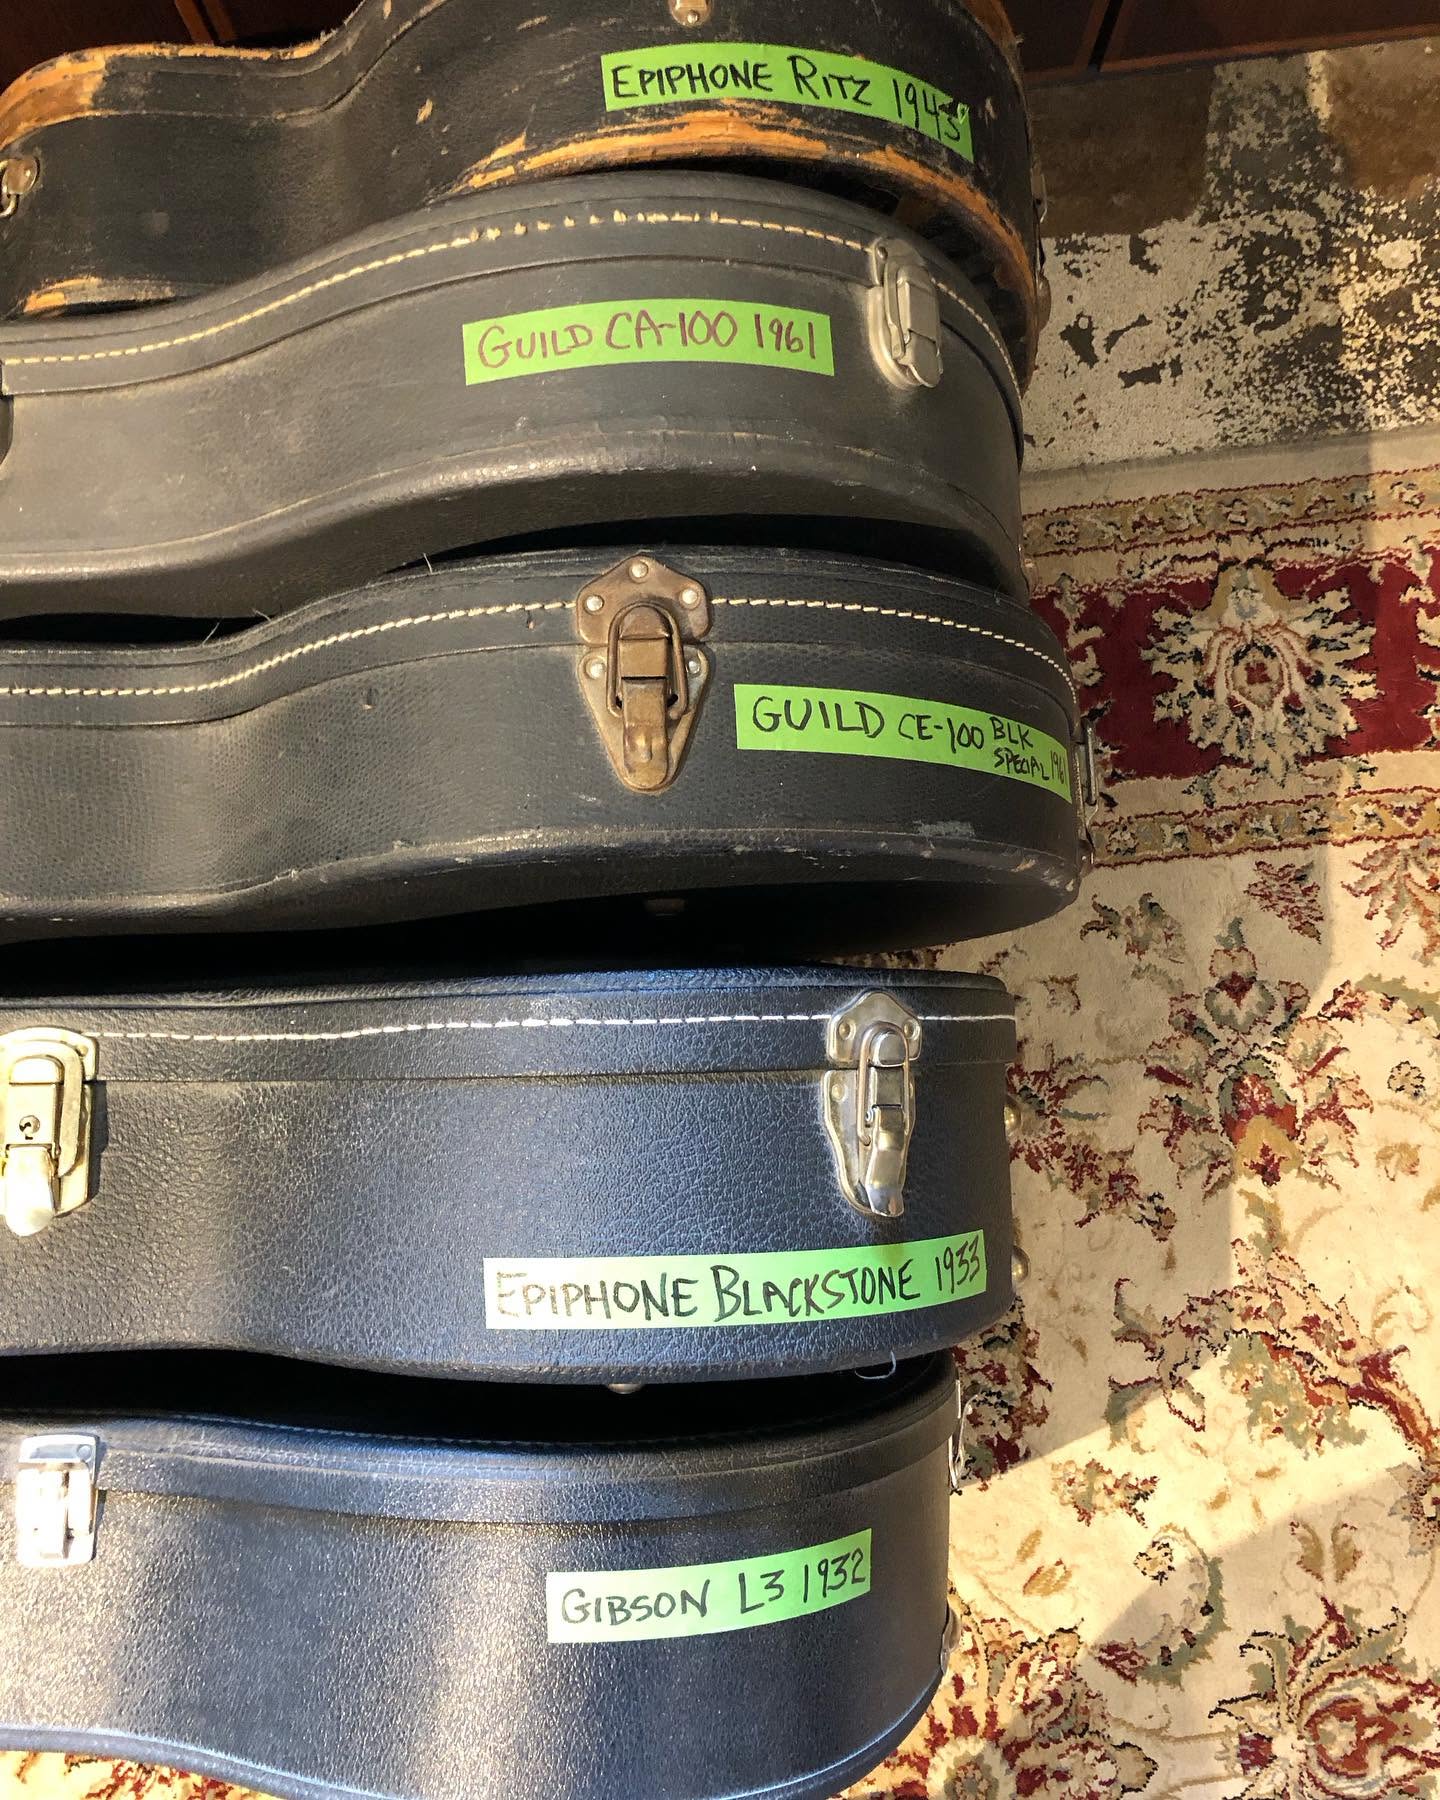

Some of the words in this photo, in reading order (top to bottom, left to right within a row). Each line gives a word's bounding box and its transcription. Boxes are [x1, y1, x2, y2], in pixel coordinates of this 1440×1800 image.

[611, 60, 773, 98] EPIPHONE
[787, 55, 872, 106] RITZ
[478, 323, 593, 369] GUILD
[604, 309, 738, 349] CA-100
[754, 312, 816, 360] 1961
[752, 696, 885, 738] GUILD
[898, 713, 984, 754] CE-100
[989, 716, 1034, 750] BLK
[496, 1271, 698, 1321] EPIPHONE
[711, 1264, 921, 1322] BLACKSTONE
[935, 1237, 982, 1294] 1933
[560, 1578, 710, 1627] GIBSON
[738, 1569, 786, 1615] L3
[803, 1548, 867, 1603] 1932
